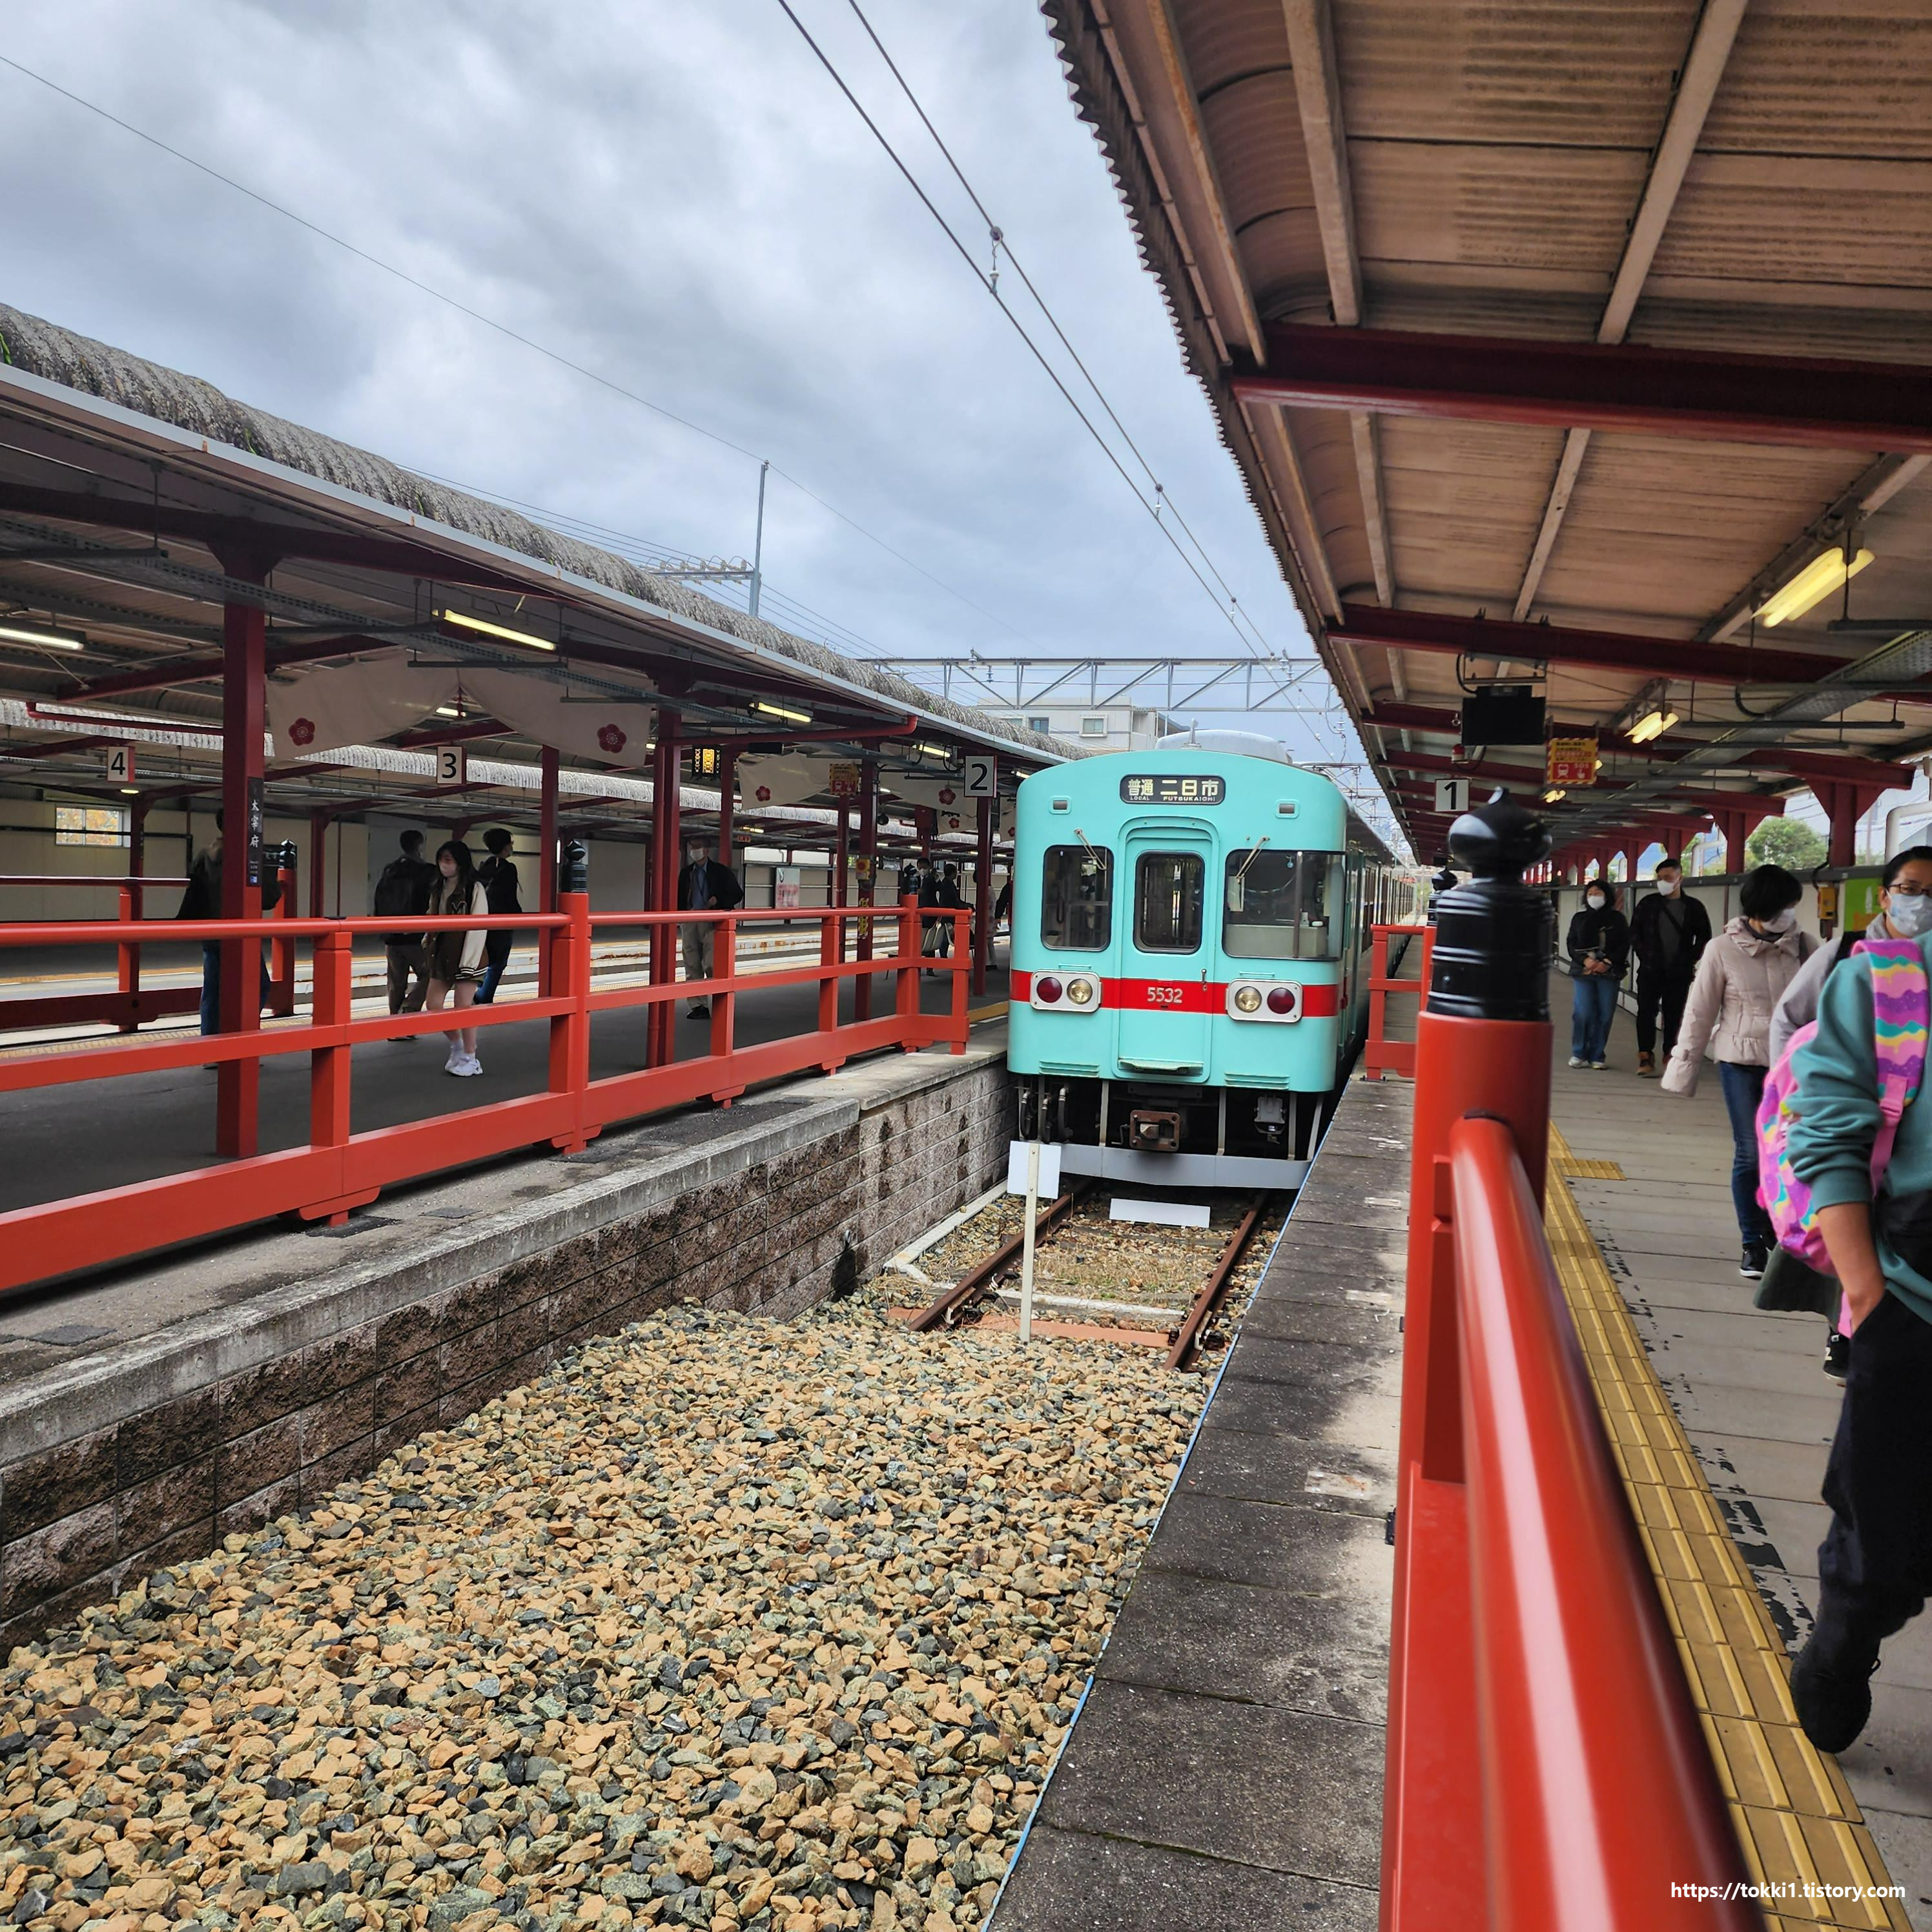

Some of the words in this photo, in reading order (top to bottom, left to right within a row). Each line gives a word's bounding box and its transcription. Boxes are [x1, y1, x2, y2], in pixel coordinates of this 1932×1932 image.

[111, 752, 126, 776] 4
[442, 752, 457, 779] 3
[971, 763, 988, 790] 2
[1128, 779, 1154, 796] 普通
[1160, 779, 1219, 797] 二日市
[1444, 781, 1457, 810] 1
[250, 799, 260, 848] 太宰府
[1147, 987, 1183, 1003] 5532
